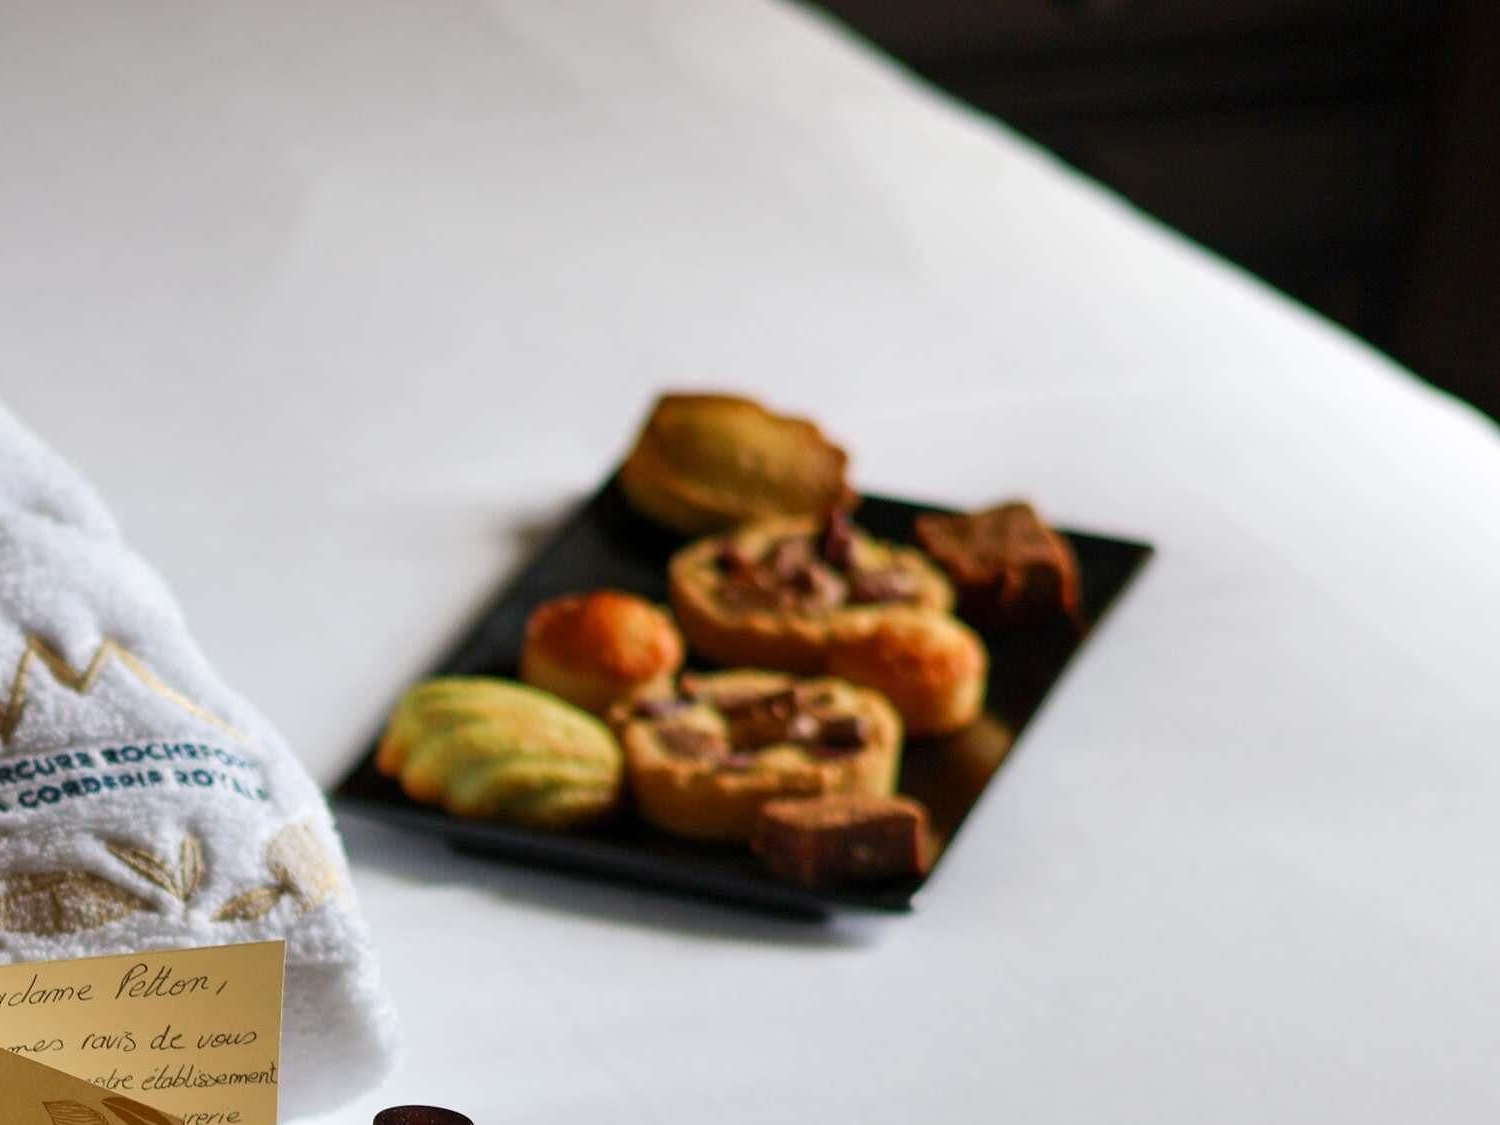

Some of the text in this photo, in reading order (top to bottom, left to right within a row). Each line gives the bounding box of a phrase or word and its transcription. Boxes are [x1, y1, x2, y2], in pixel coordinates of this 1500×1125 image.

[81, 1031, 137, 1052] ravis
[150, 1024, 186, 1050] de
[197, 1030, 258, 1049] vous
